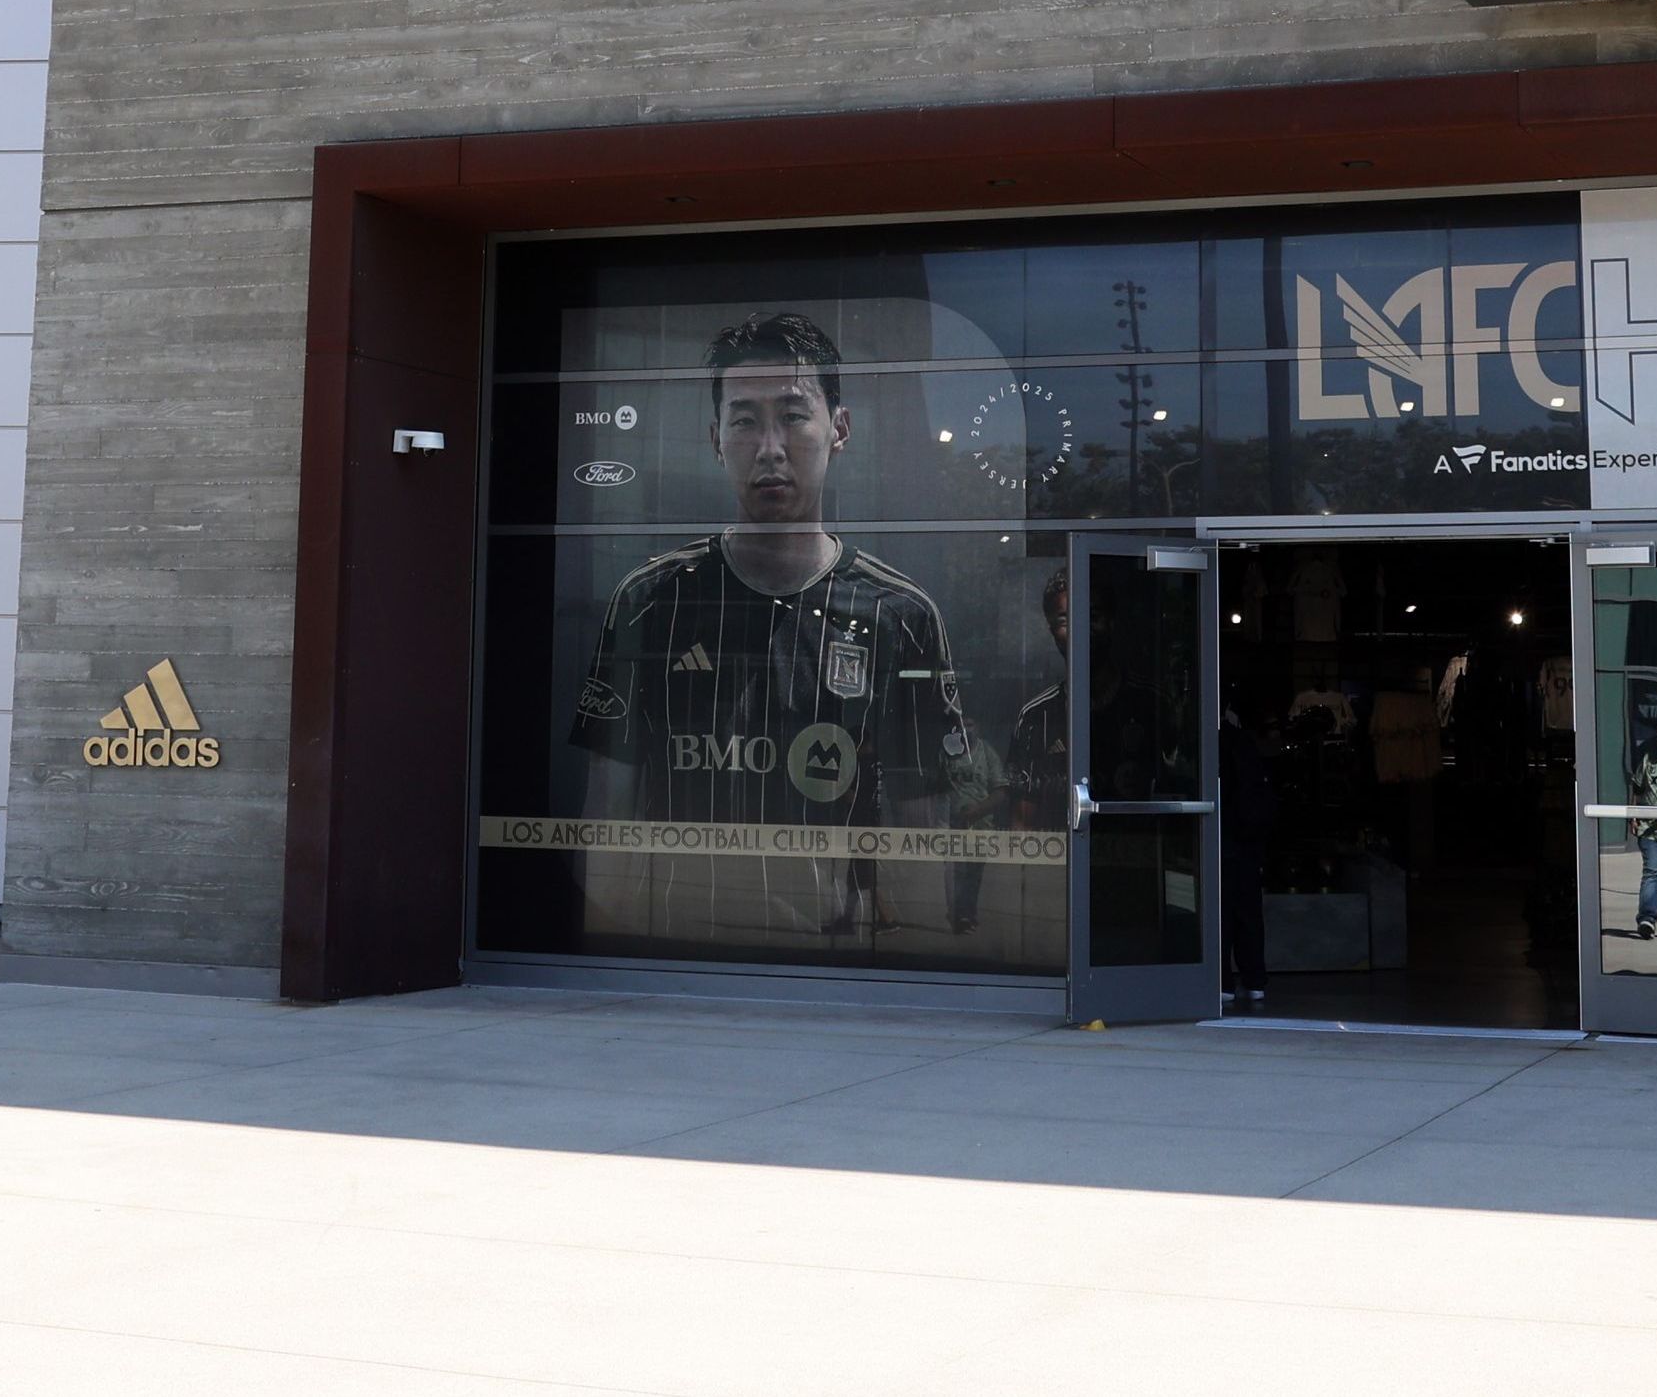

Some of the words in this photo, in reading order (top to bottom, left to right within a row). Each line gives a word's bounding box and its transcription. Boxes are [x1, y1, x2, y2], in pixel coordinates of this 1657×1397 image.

[1296, 260, 1581, 422] LAFC
[575, 412, 611, 425] BMO
[970, 382, 1054, 437] 2024/2025
[1041, 407, 1073, 483] PRIMARY
[1433, 455, 1452, 474] A
[1490, 450, 1588, 473] Fanatics
[585, 464, 624, 482] Ford
[972, 451, 1028, 490] JERSEY
[83, 727, 220, 768] adidas
[671, 734, 777, 775] BMO
[502, 821, 543, 844] LOS
[550, 823, 643, 847] ANGELES
[650, 826, 765, 852] FOOTBALL
[773, 829, 829, 852] CLUB
[847, 831, 891, 854] LOS
[901, 833, 1000, 858] ANGELES
